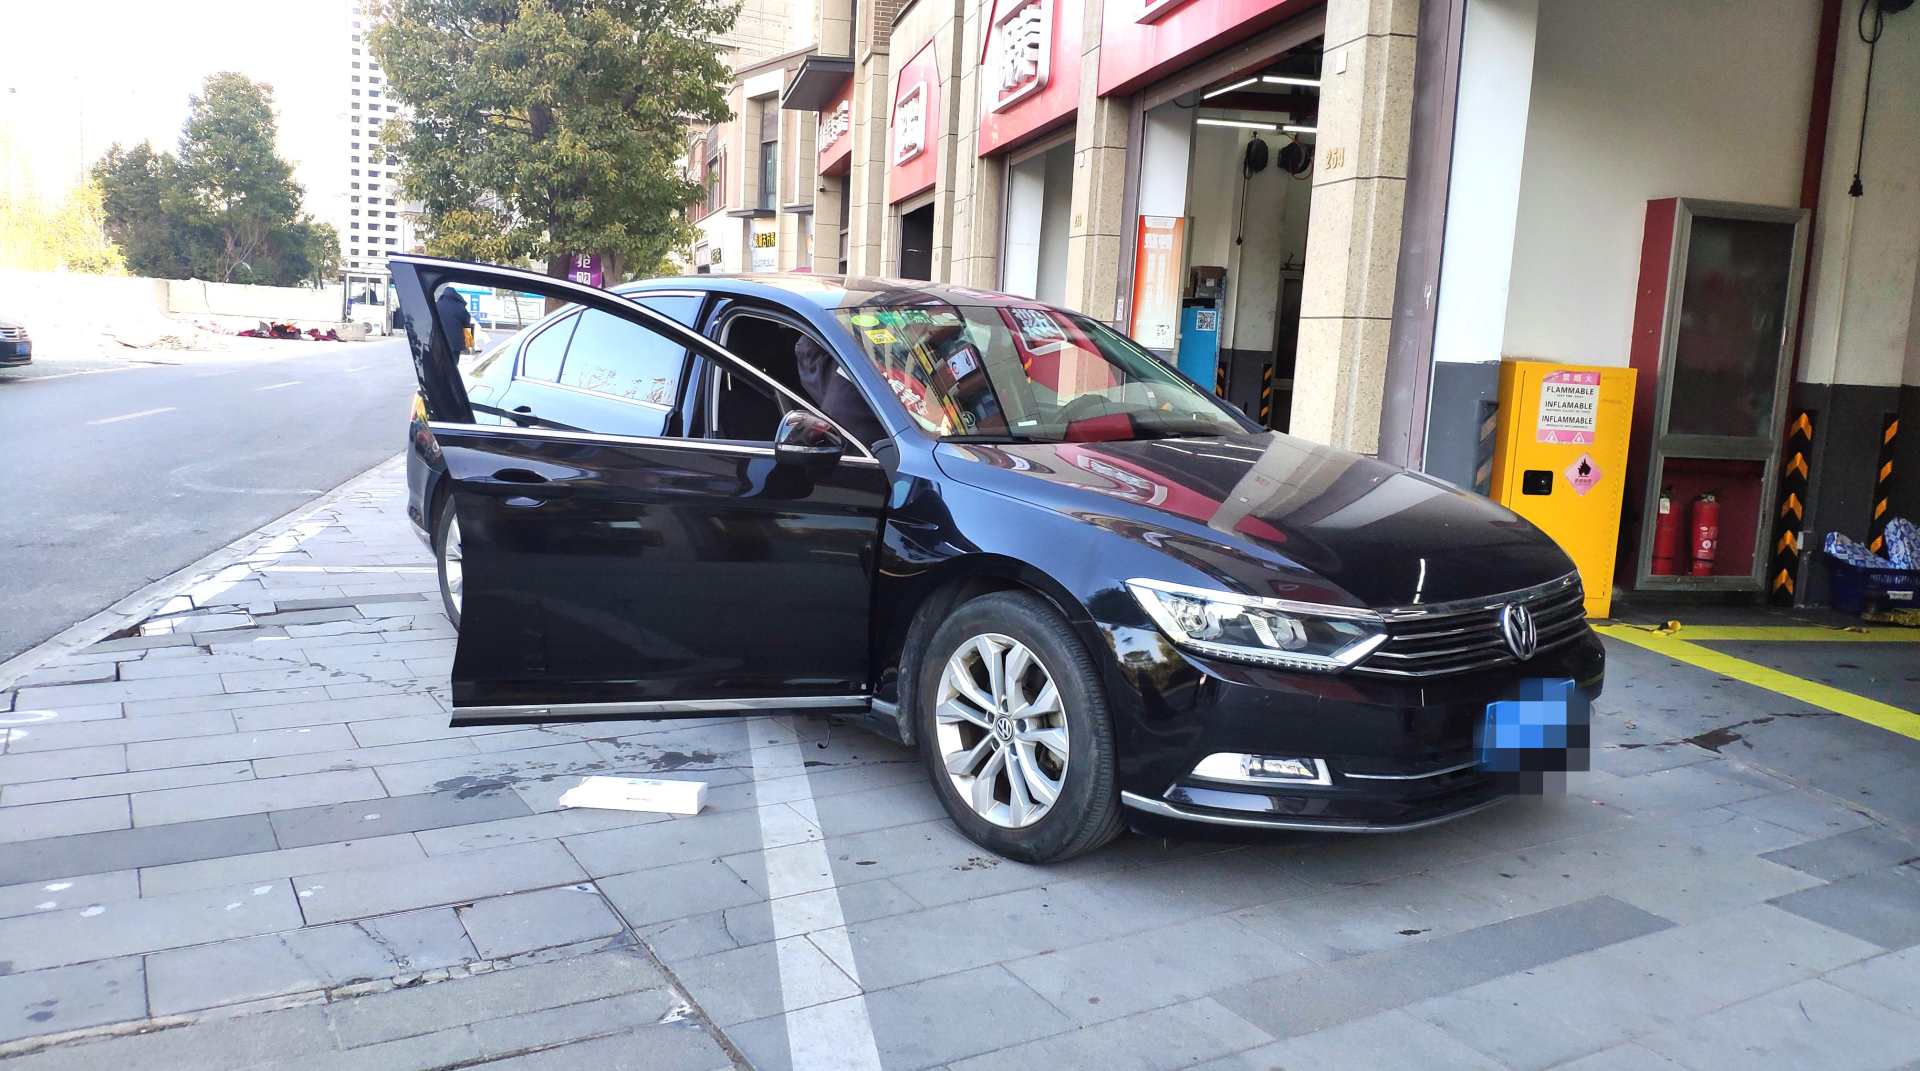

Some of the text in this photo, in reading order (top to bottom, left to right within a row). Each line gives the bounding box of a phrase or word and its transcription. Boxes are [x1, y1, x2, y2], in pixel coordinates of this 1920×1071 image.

[1546, 386, 1594, 396] FLAMMABLE
[1545, 401, 1593, 410] INFLAMABLE
[1542, 415, 1593, 425] INFLAMMABLE
